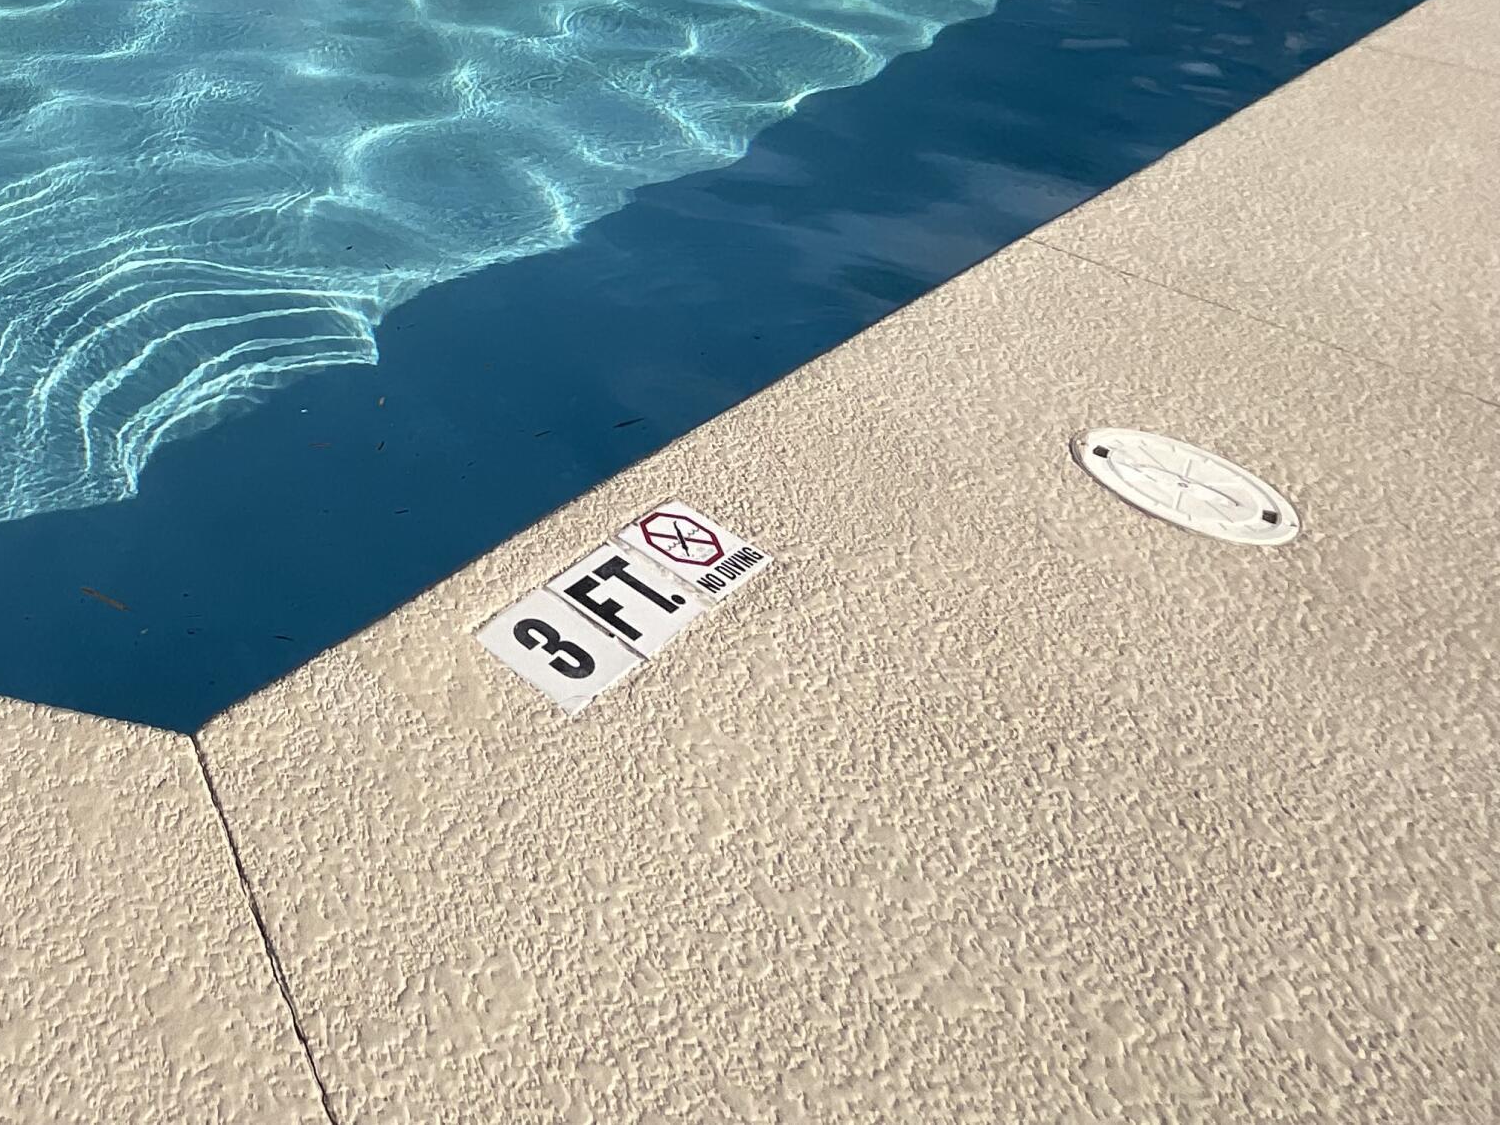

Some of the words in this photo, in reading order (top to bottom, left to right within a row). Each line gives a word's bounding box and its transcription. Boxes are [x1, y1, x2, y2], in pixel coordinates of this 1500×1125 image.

[696, 573, 726, 593] NO
[714, 547, 764, 580] DIVING
[513, 618, 595, 679] 3
[563, 555, 686, 641] FT.
